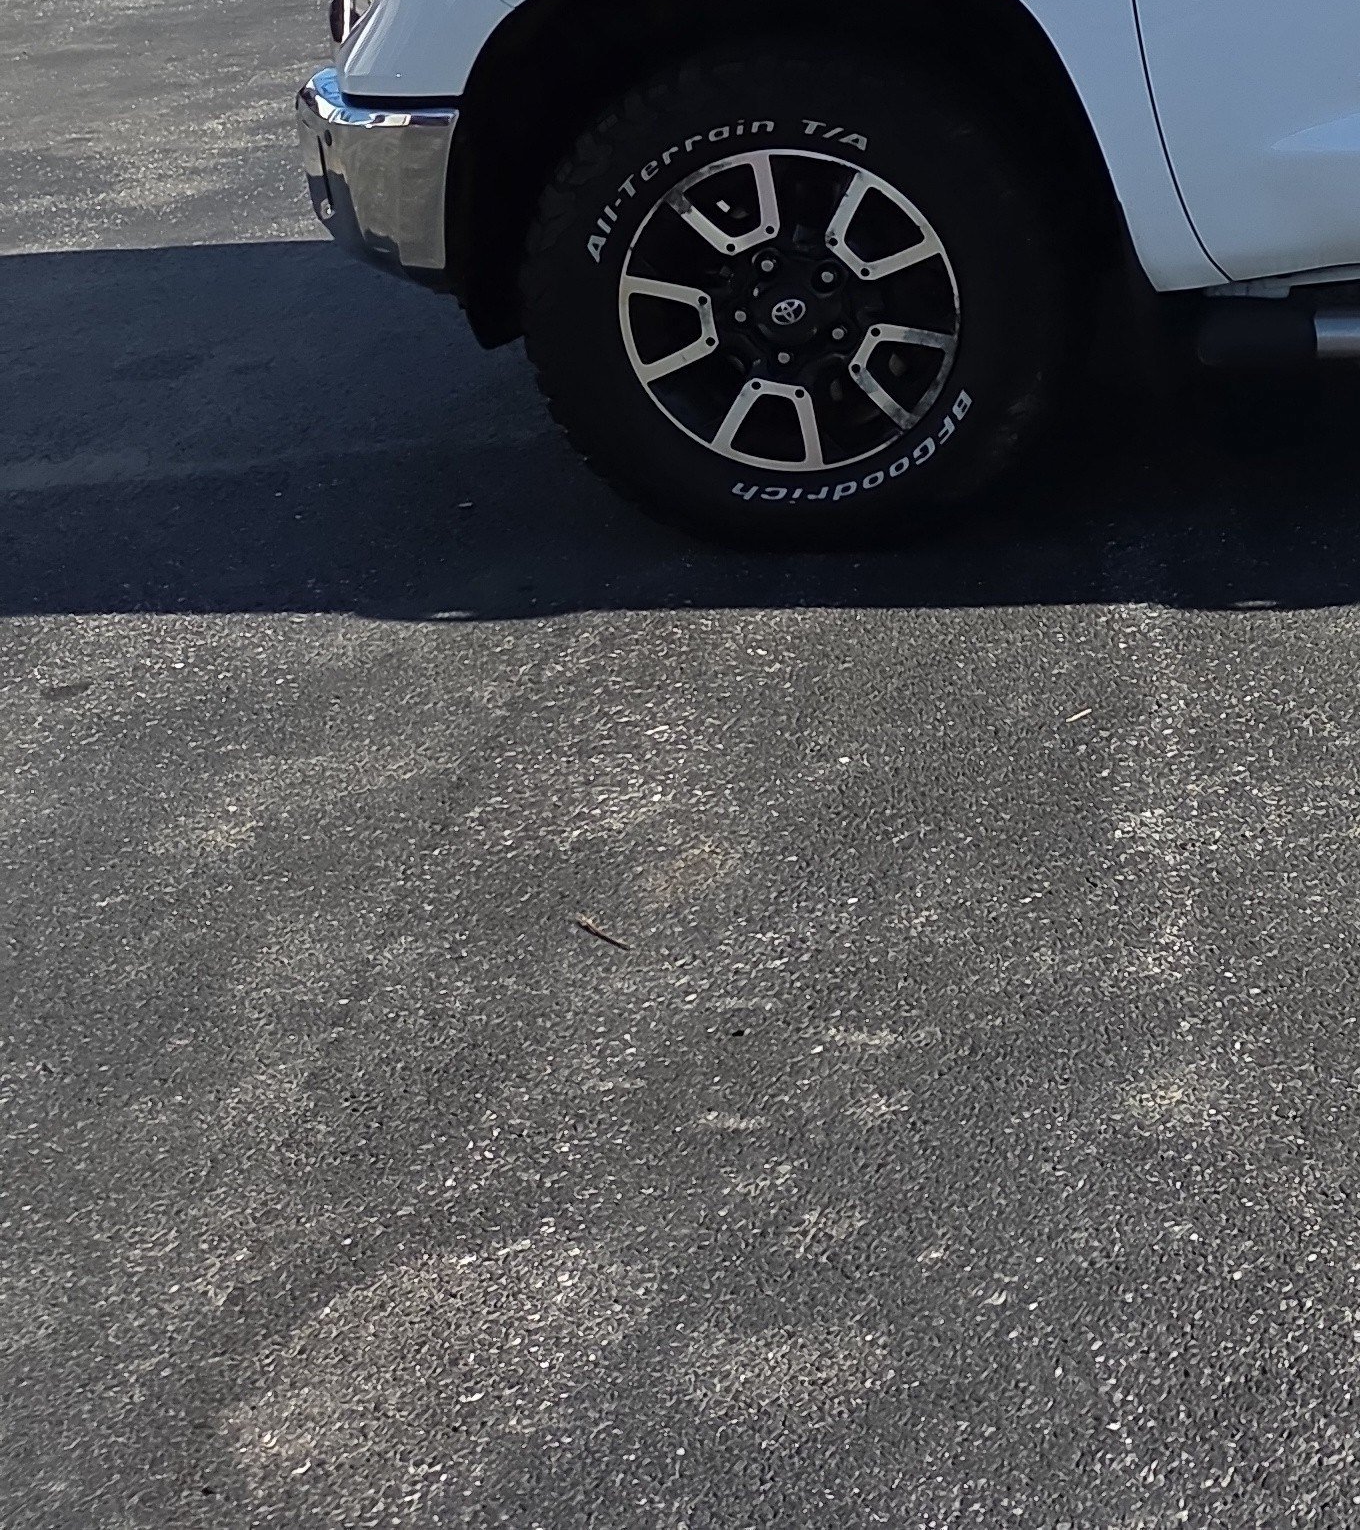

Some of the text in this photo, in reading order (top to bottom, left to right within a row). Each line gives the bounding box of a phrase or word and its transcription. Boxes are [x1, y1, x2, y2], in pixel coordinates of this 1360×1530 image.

[587, 118, 870, 263] All-Terrain T/A
[731, 389, 974, 505] BFGoodrich
